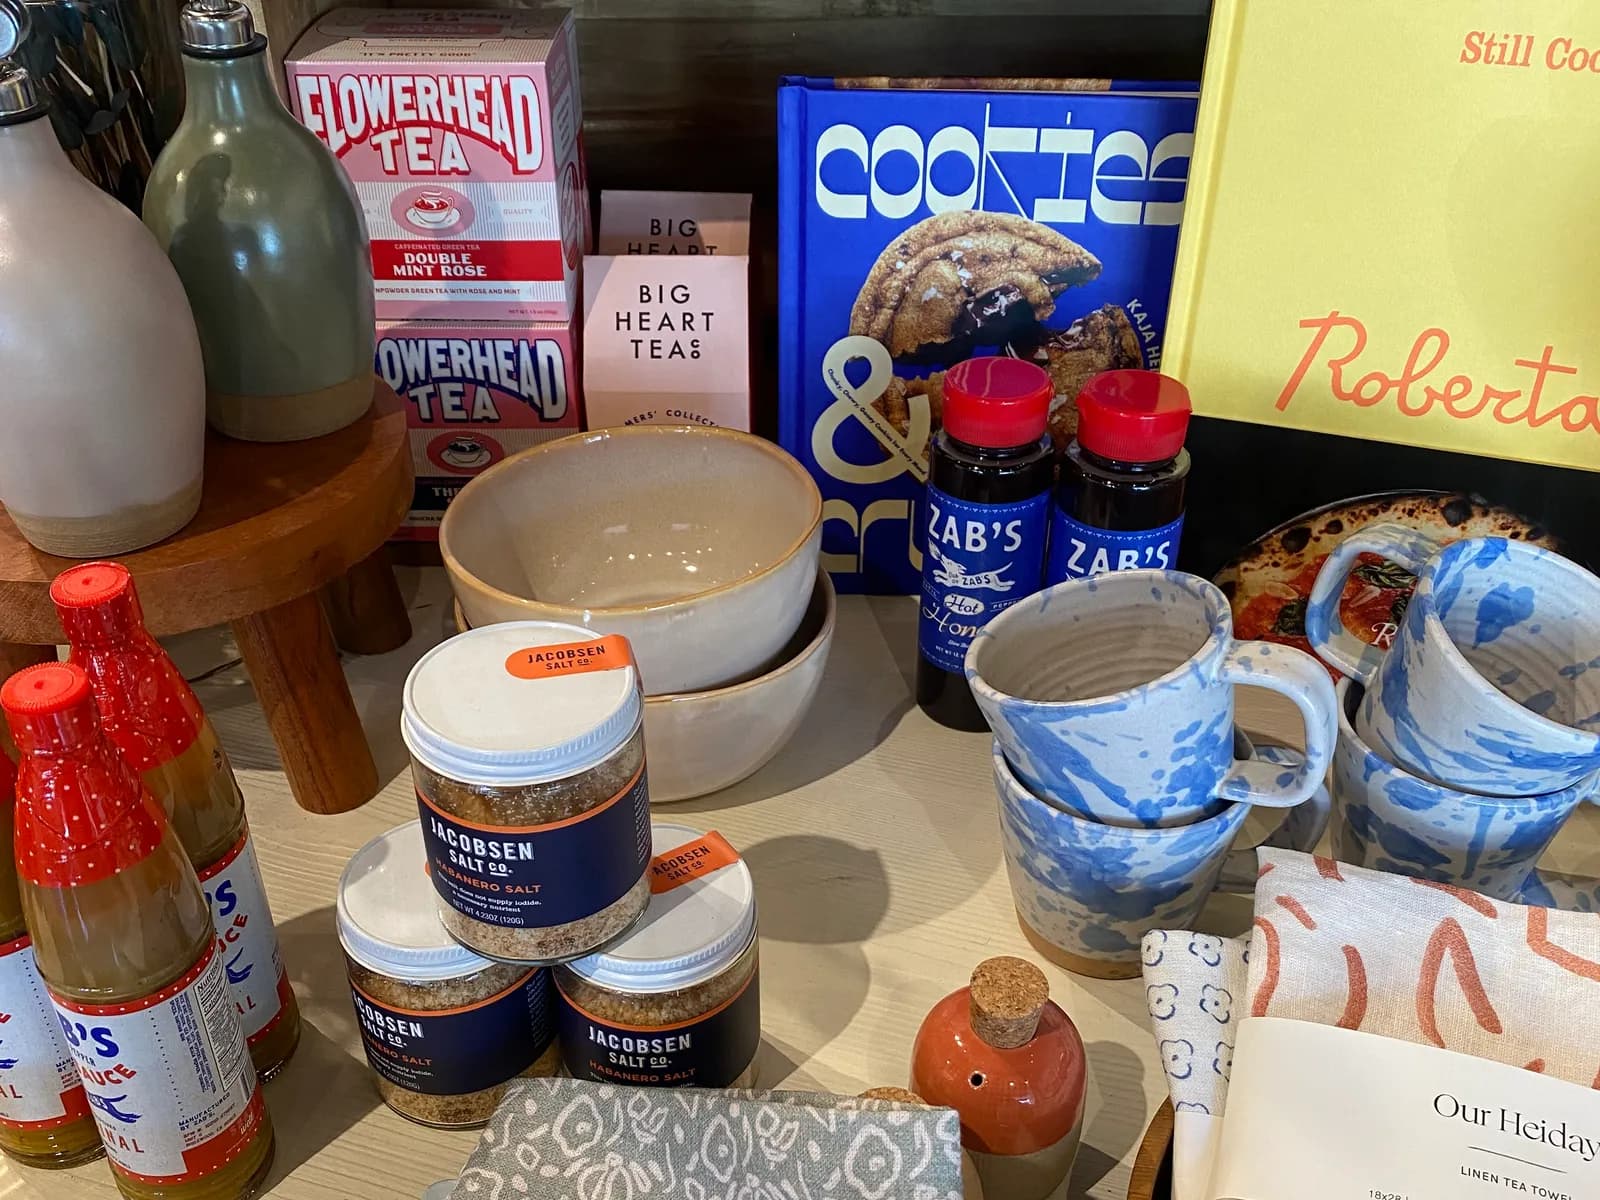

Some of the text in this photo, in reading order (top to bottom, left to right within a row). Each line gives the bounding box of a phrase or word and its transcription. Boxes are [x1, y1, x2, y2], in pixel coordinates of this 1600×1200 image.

[1459, 31, 1534, 67] Still
[295, 73, 544, 175] FLOWERHEAD
[370, 126, 471, 175] TEA
[651, 219, 697, 237] BIG
[404, 253, 472, 265] DOUBLE
[393, 265, 487, 277] MINT ROSE
[640, 284, 690, 304] BIG
[616, 312, 714, 331] HEART
[1126, 298, 1160, 371] KAJA HE
[630, 339, 686, 359] TEA
[408, 382, 501, 423] TEA
[875, 422, 892, 441] Cookies
[928, 502, 1022, 552] ZAB'S
[1067, 538, 1170, 575] ZAB'S
[962, 574, 991, 586] ZAB'S
[944, 594, 979, 614] Hot
[528, 644, 606, 664] JACOBSEN
[546, 658, 593, 670] SALT CO.
[431, 816, 535, 860] JACOBSEN
[449, 849, 514, 877] SALT CO.
[668, 866, 691, 880] SALT
[436, 857, 542, 894] HABANERO SALT
[489, 905, 521, 913] nutrient
[388, 1033, 408, 1048] CO.
[588, 1026, 691, 1054] JACOBSEN
[401, 1055, 433, 1066] SALT
[608, 1052, 672, 1068] SALT CO.
[77, 1063, 137, 1086] AUCE
[589, 1060, 696, 1082] HABANERO SALT
[178, 1092, 231, 1126] MANUFACTURED
[1433, 1093, 1600, 1162] Our Heiday
[1461, 1165, 1499, 1184] LINEN
[1503, 1176, 1527, 1192] TEA
